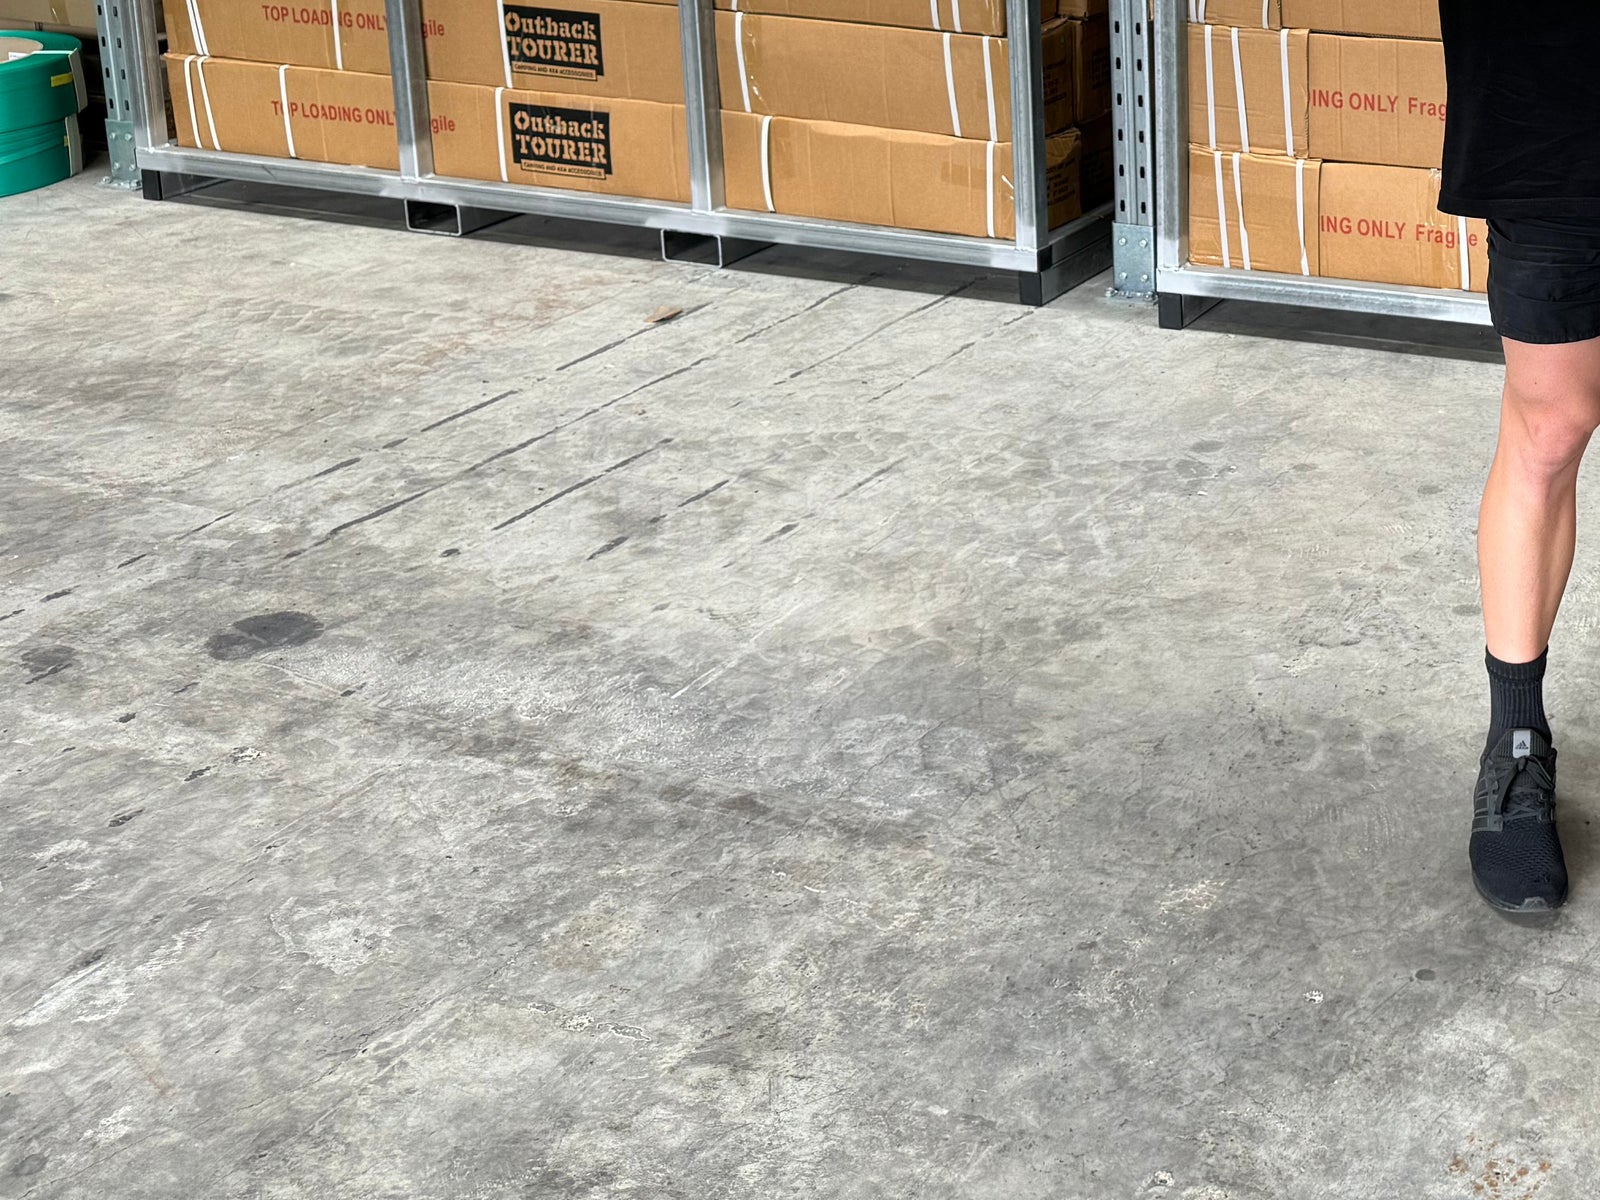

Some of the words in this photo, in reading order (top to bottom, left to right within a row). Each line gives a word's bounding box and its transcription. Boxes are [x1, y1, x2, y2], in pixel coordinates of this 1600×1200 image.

[262, 5, 289, 23] TOP
[504, 11, 597, 40] Outback
[505, 36, 599, 65] TOURER
[271, 100, 298, 117] TP
[302, 103, 362, 123] LOADING
[1312, 89, 1344, 109] ING
[1349, 92, 1399, 113] ONLY
[1408, 97, 1446, 121] Frag
[514, 109, 606, 140] Outback
[516, 134, 607, 165] TOURER
[1321, 215, 1352, 235] ING
[1357, 219, 1406, 240] ONLY
